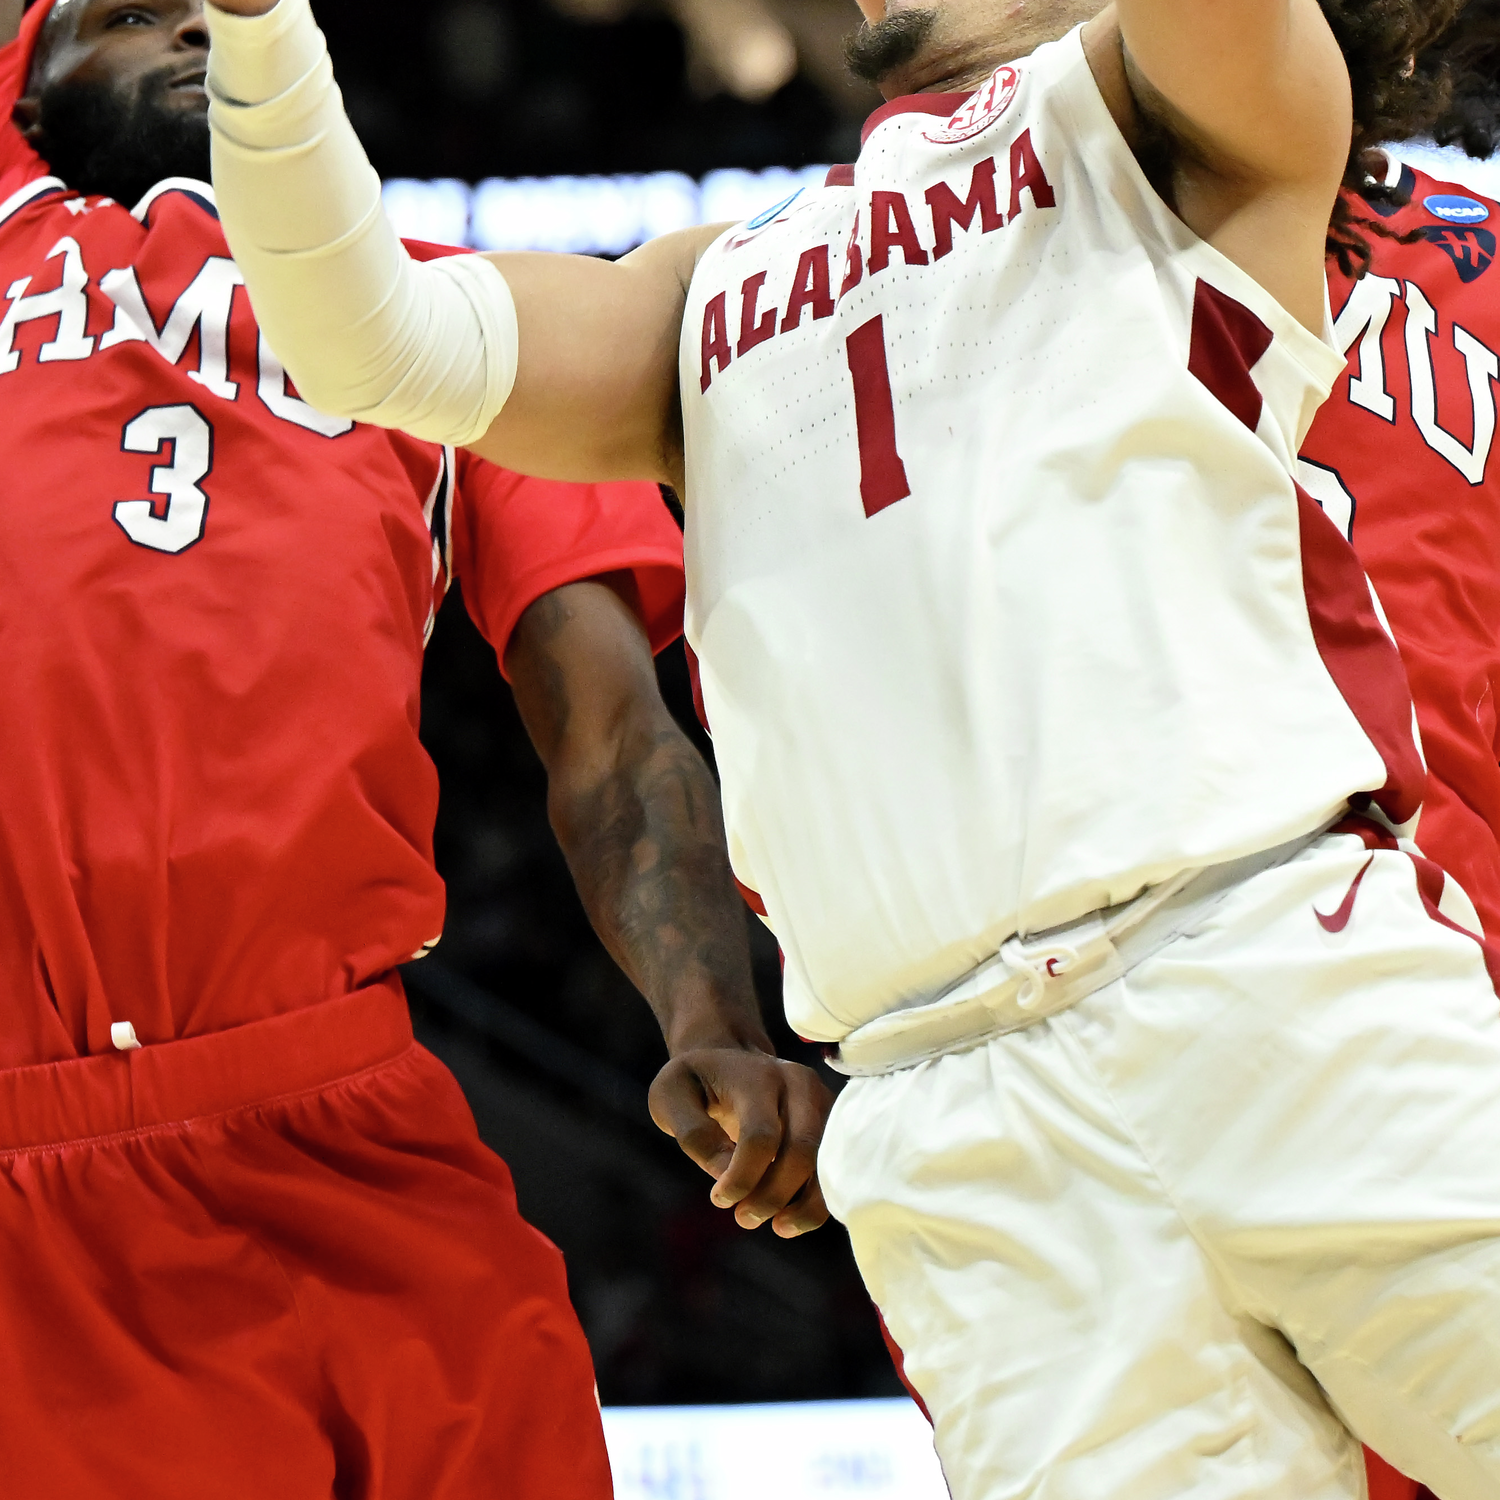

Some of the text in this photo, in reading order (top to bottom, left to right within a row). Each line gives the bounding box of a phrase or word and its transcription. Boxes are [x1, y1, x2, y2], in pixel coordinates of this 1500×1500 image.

[948, 67, 1014, 130] SEC
[846, 313, 911, 519] 1
[1333, 271, 1500, 487] MU
[111, 402, 214, 555] 3
